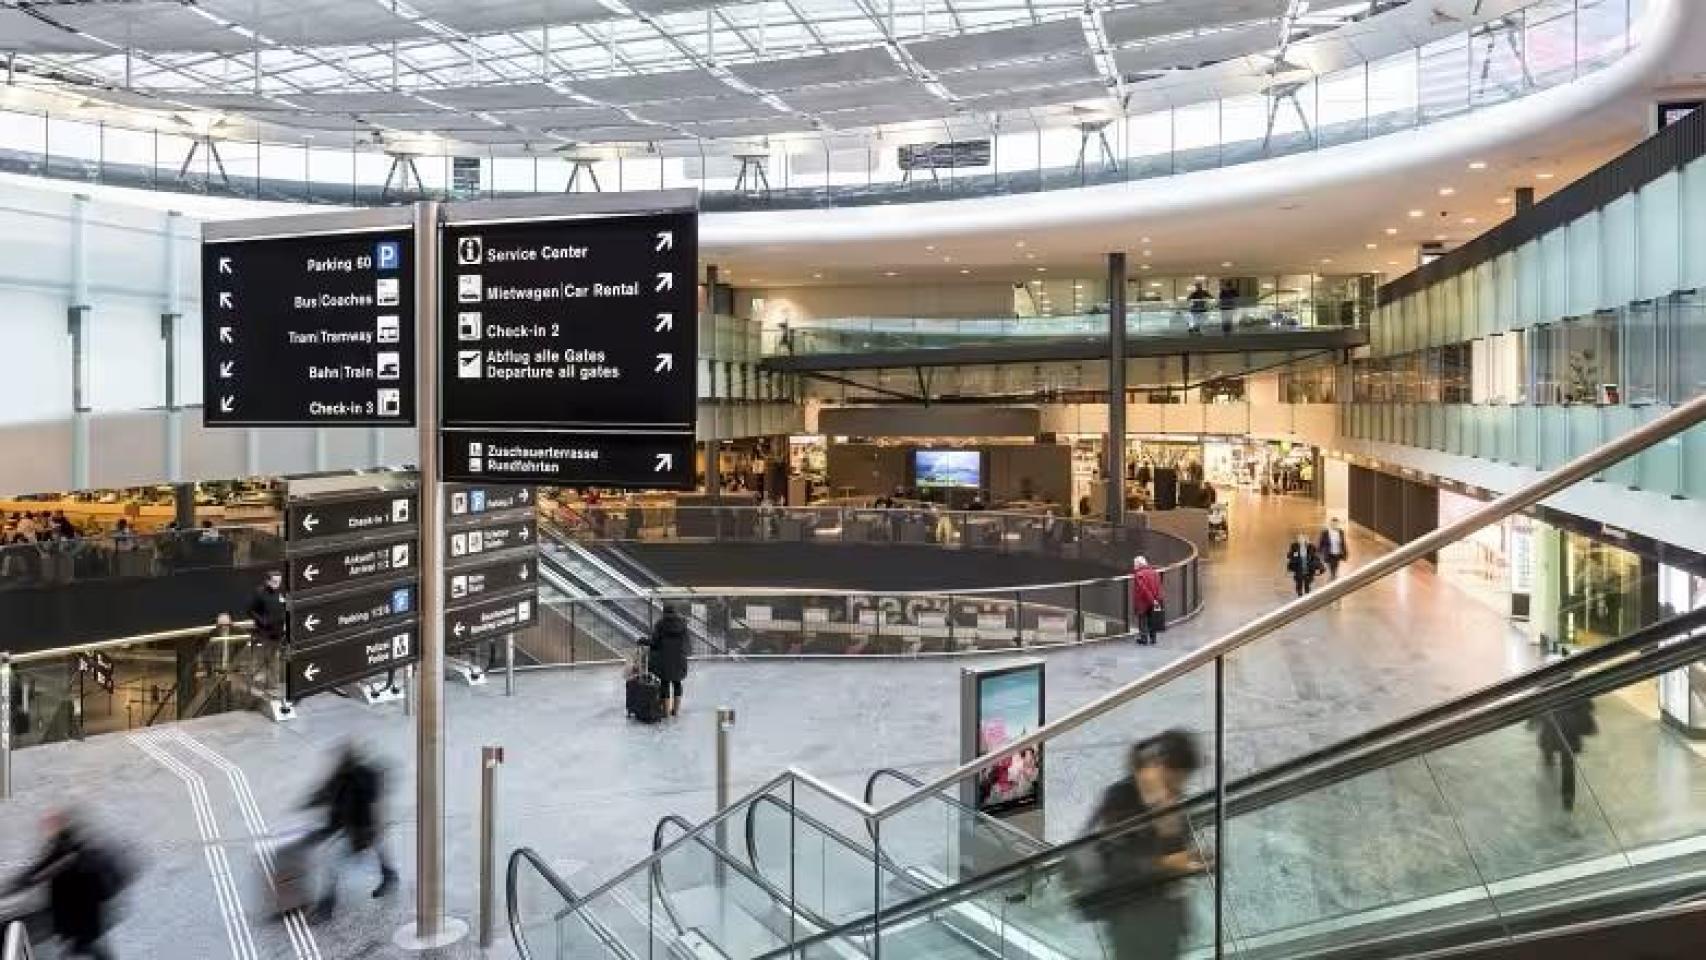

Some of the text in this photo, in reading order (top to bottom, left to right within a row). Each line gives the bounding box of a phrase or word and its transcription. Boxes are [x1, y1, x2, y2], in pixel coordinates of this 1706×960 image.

[487, 245, 589, 262] Service Center
[307, 257, 352, 273] Parking
[593, 281, 639, 297] Rental
[486, 323, 560, 338] Check-in 2
[486, 348, 605, 364] Abflug alle Gates
[486, 364, 620, 381] Departure all gates
[310, 401, 374, 415] Check-in 3
